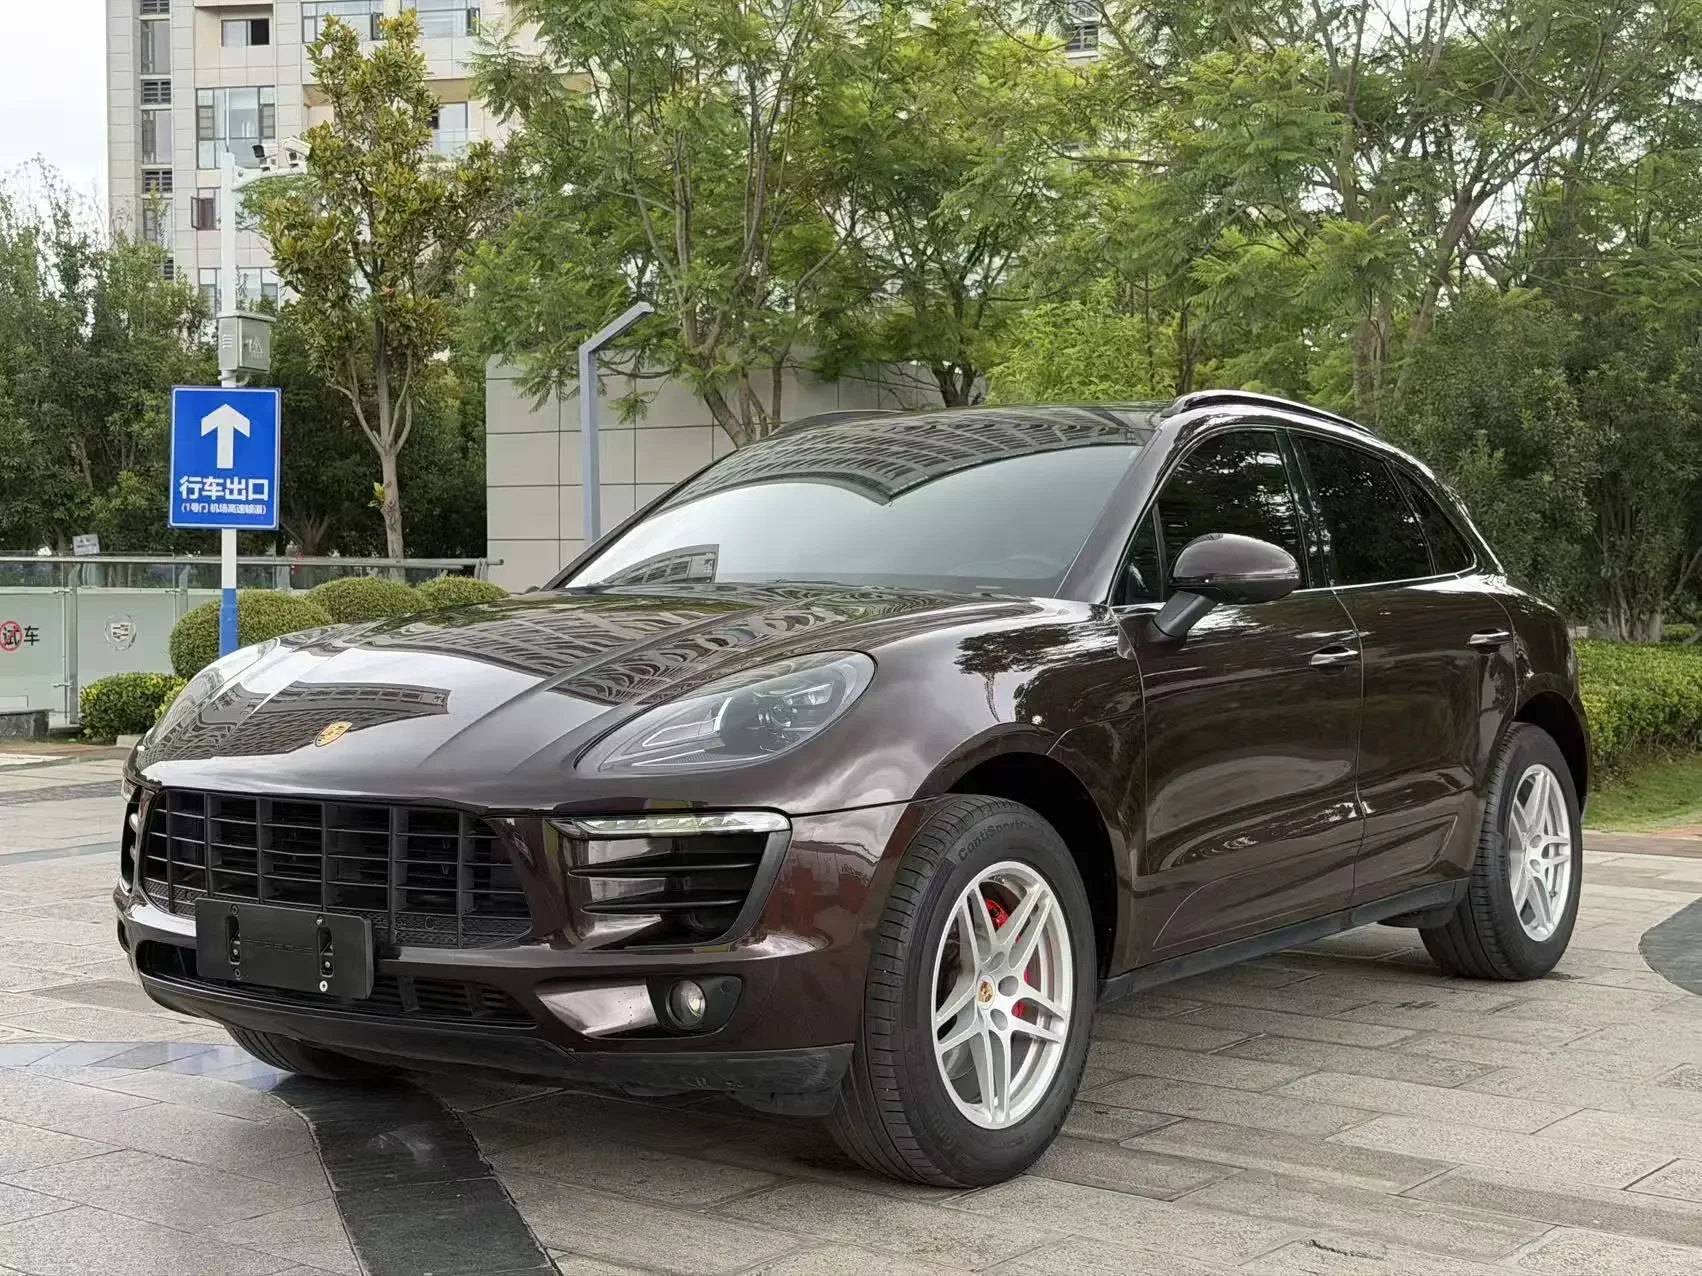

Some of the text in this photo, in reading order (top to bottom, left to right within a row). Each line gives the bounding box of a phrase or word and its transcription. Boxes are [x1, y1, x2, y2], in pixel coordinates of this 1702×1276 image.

[179, 475, 269, 501] 行车出口
[181, 502, 208, 513] (1号门
